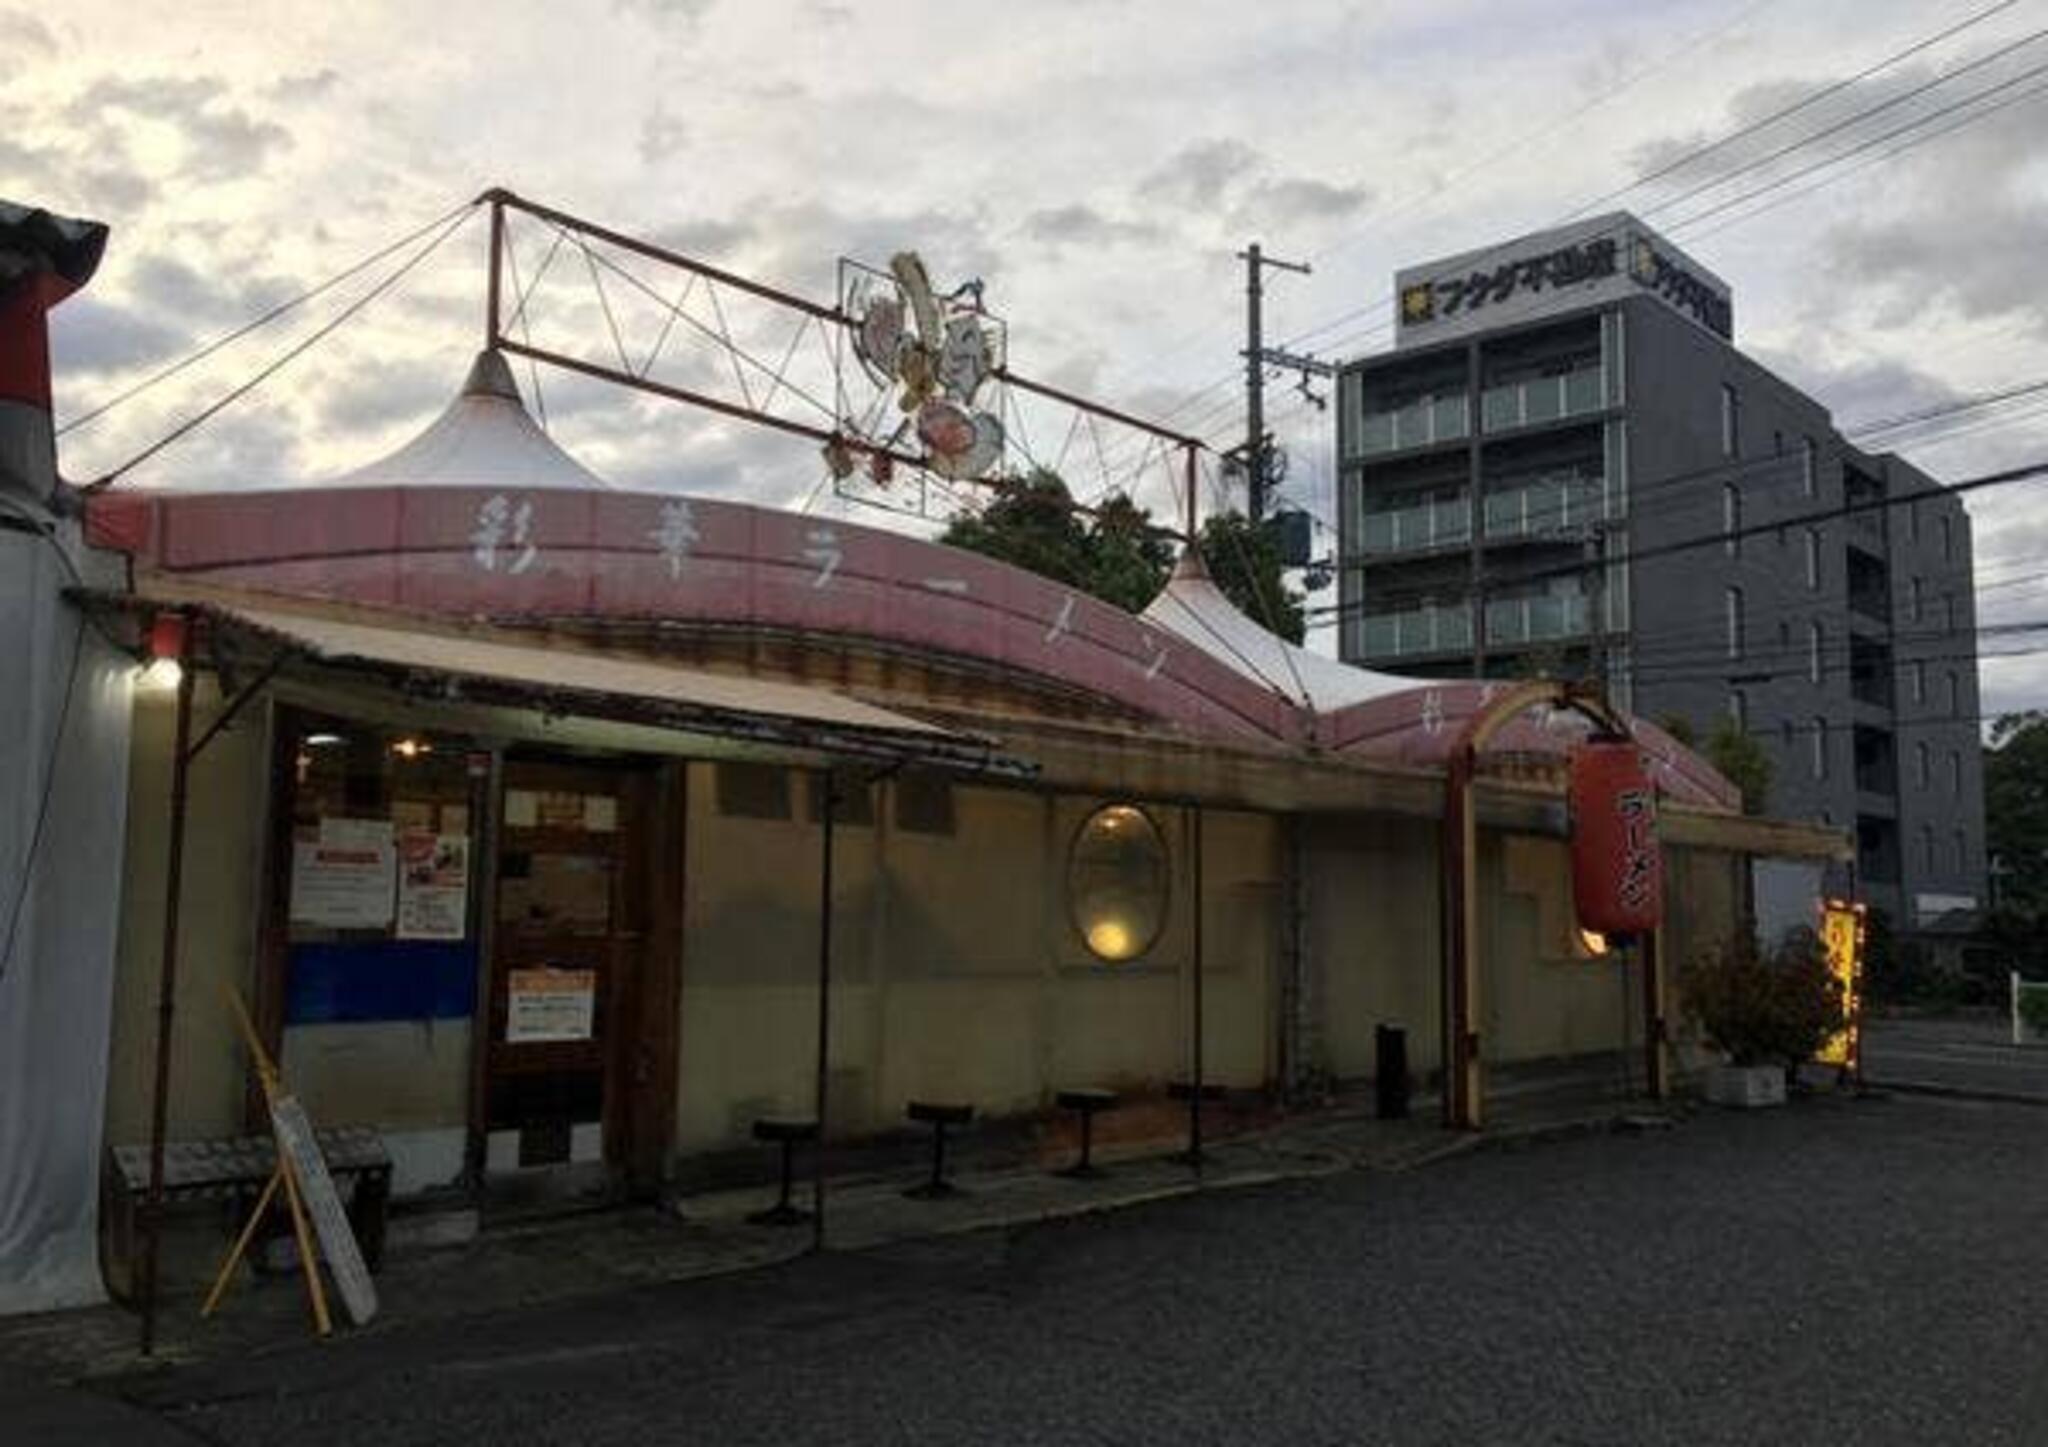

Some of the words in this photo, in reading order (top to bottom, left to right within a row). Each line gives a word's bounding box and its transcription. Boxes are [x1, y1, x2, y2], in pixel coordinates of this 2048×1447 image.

[470, 494, 1171, 681] 彩華ラーメン
[1619, 790, 1650, 910] ラーメン
